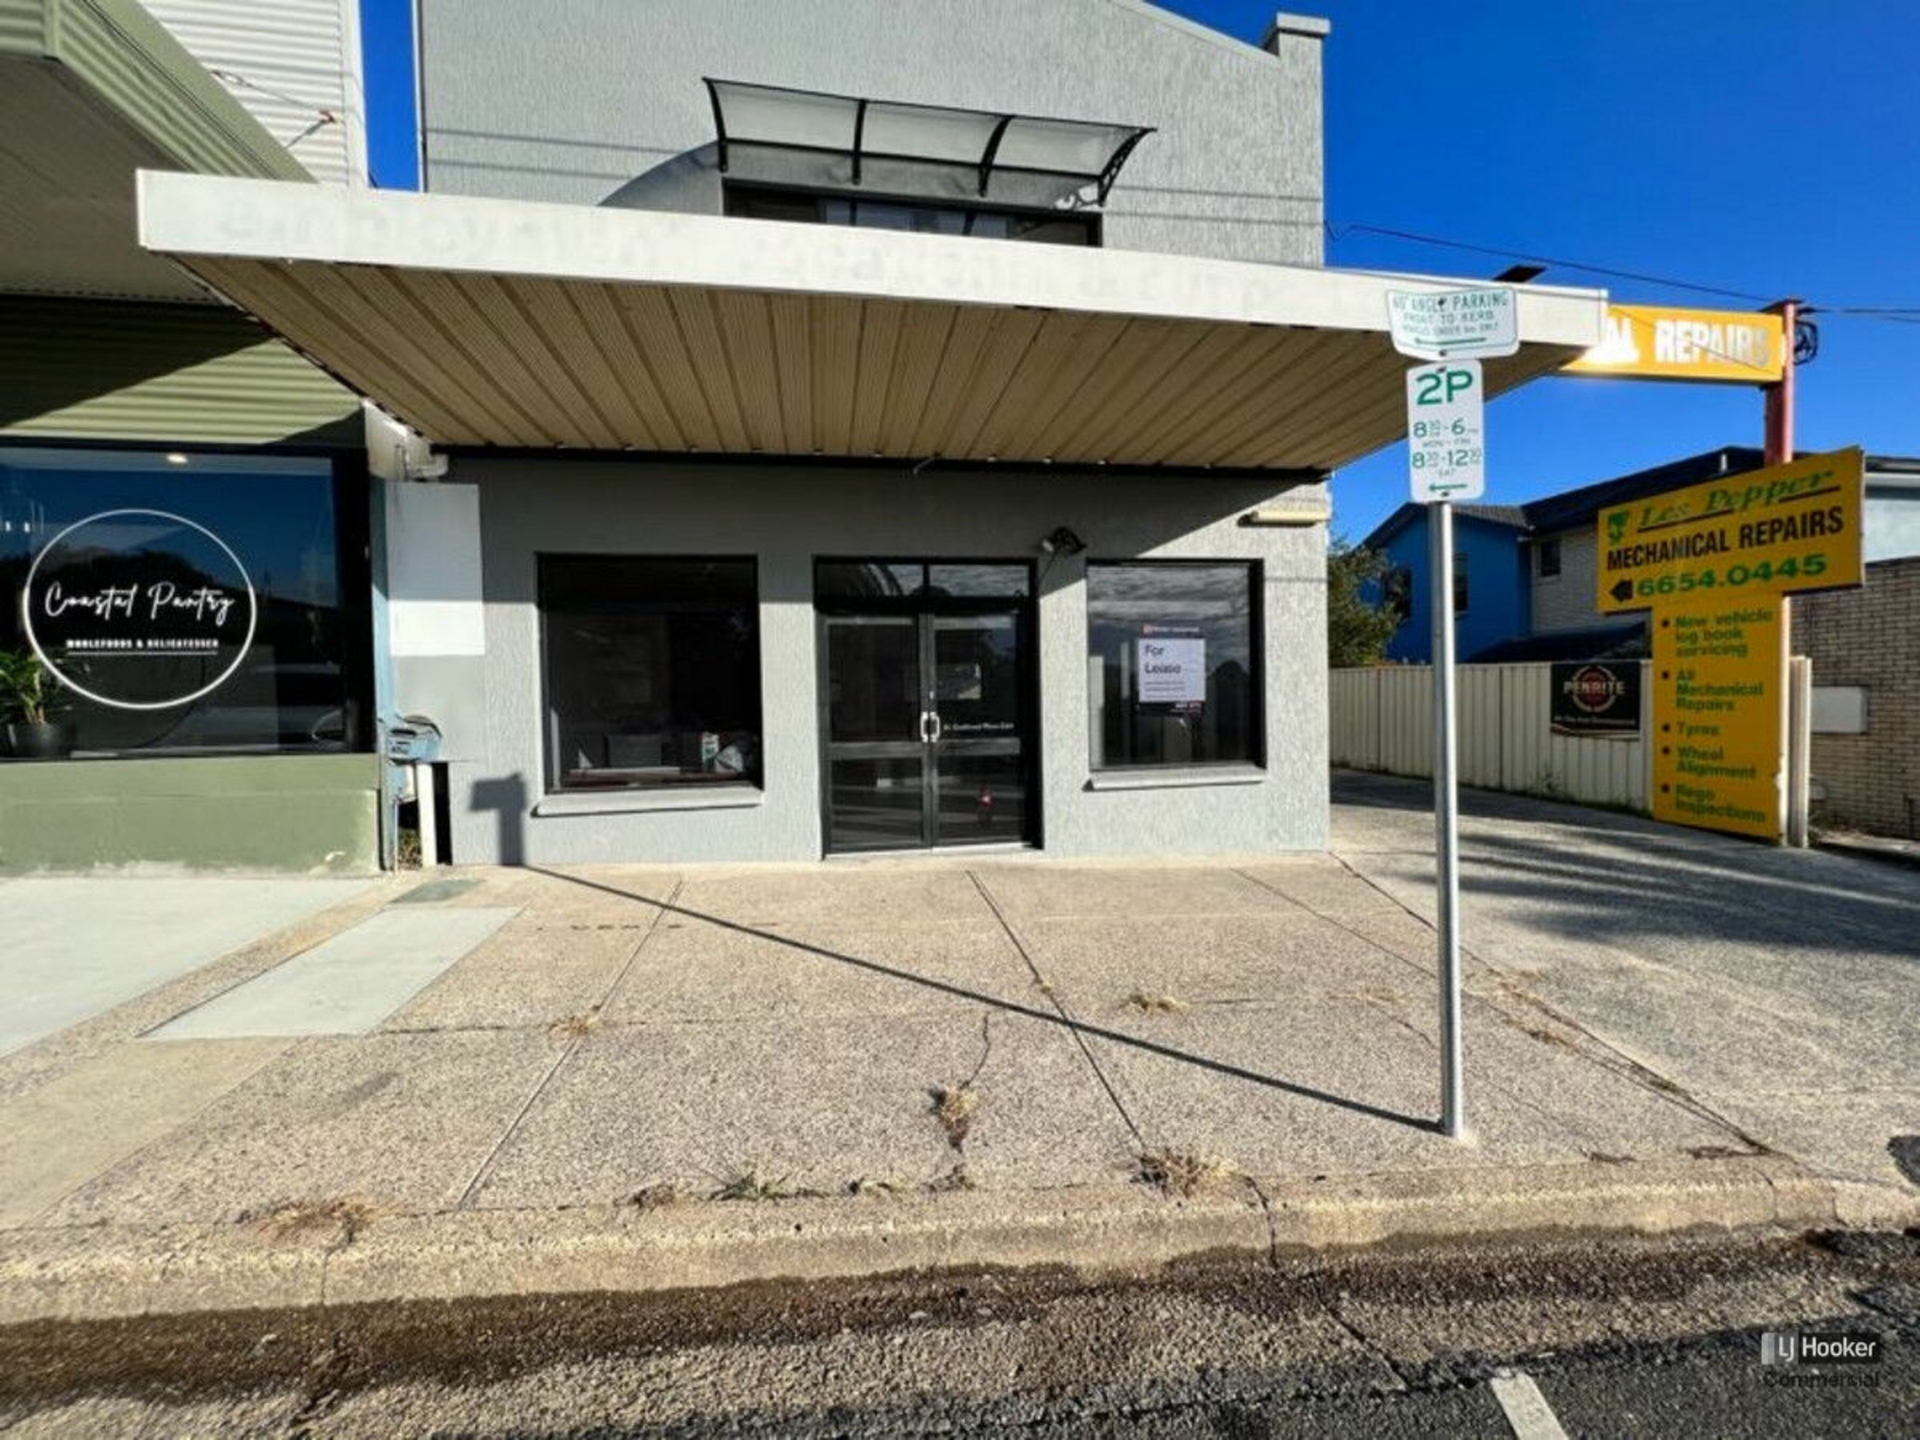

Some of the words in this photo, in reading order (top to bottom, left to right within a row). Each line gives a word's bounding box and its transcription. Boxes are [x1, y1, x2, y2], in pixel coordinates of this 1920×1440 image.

[1453, 291, 1509, 311] PARKING
[1440, 313, 1455, 325] TO
[1653, 318, 1769, 370] REPAIRS
[1415, 369, 1474, 406] 2P
[1703, 470, 1834, 512] Pepper
[1607, 528, 1731, 572] MECHANICAL
[1738, 506, 1845, 549] REPAIRS
[1636, 553, 1829, 597] 6654.0445
[44, 580, 139, 622] Coastal
[147, 580, 237, 627] Pantry
[1715, 607, 1773, 626] vehicle
[1676, 629, 1698, 646] log
[1702, 627, 1744, 642] book
[1144, 643, 1164, 656] For
[1676, 643, 1748, 659] servicing
[1144, 663, 1182, 675] Lease
[1676, 668, 1695, 681] All
[1563, 680, 1626, 696] PENRITE
[1676, 681, 1764, 697] Mechanical
[1676, 696, 1735, 713] Repairs
[1676, 720, 1721, 738] Tyres
[1677, 745, 1724, 761] Wheel
[1676, 761, 1757, 779] Alignment
